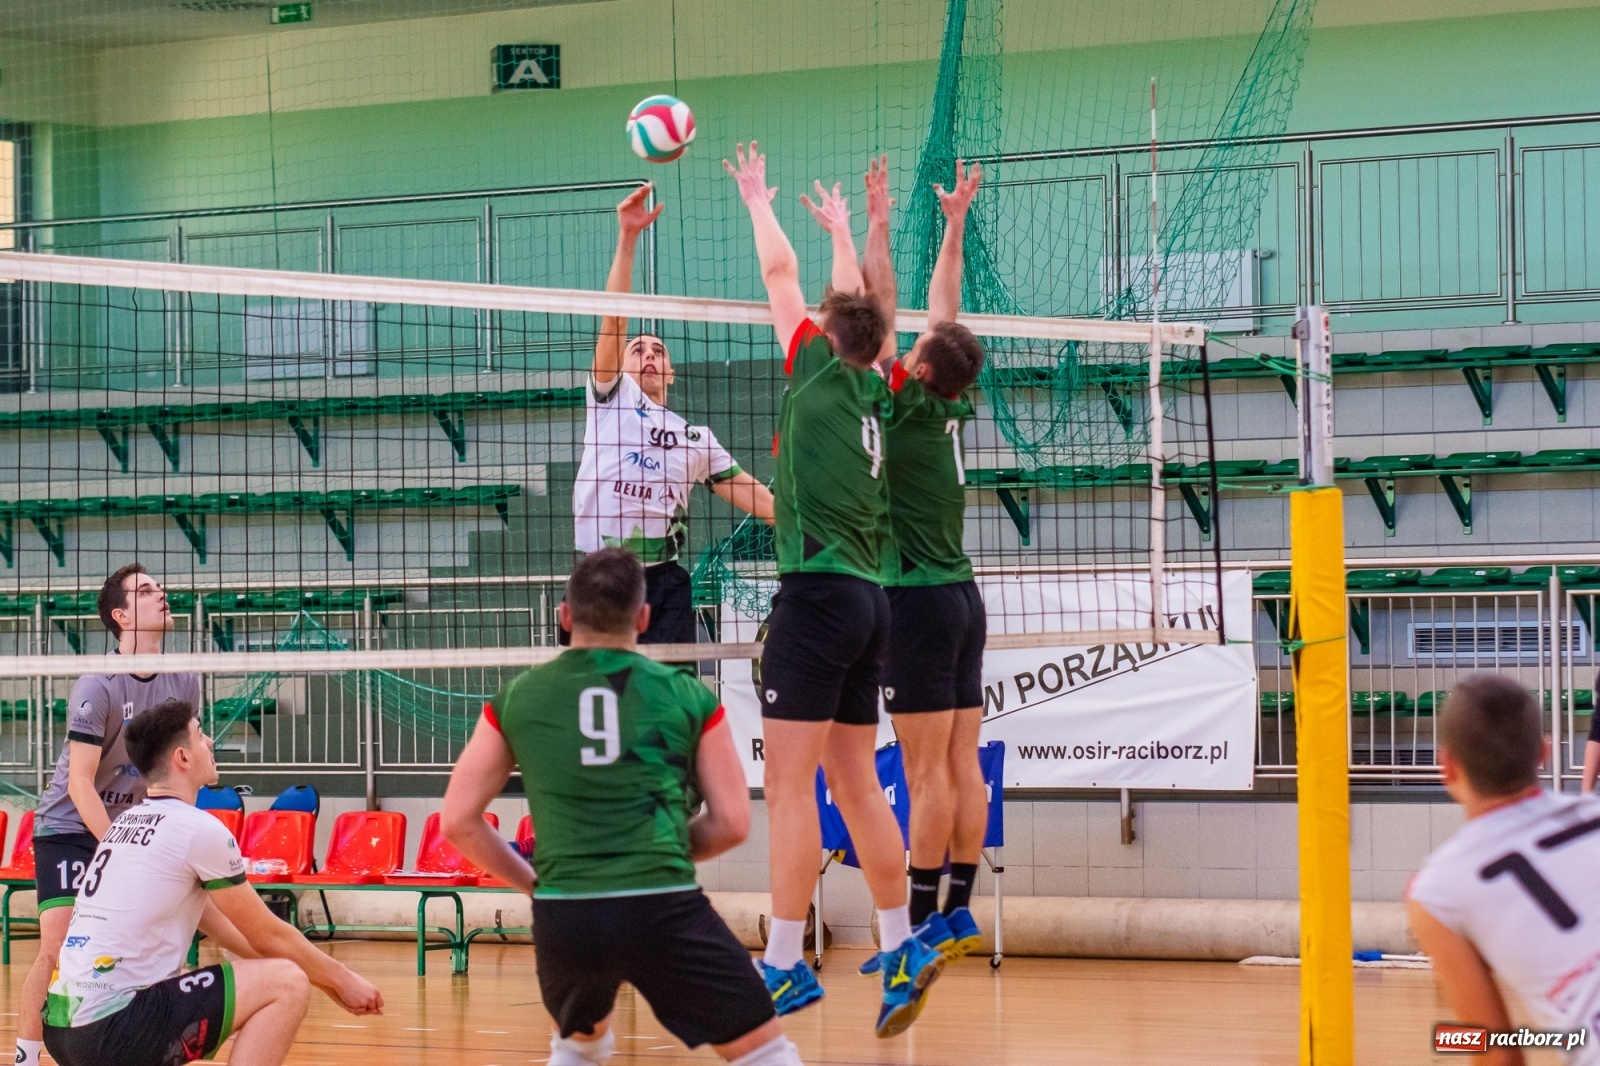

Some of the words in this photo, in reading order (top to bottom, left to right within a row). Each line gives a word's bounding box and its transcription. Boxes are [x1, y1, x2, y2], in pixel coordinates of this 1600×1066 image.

[508, 59, 549, 84] A
[613, 480, 653, 500] DELTA
[579, 687, 621, 766] 9
[1018, 740, 1229, 765] www.osir-raciborz.pl
[102, 825, 156, 847] DZINIEC
[57, 860, 86, 890] 12
[84, 848, 113, 898] 3
[179, 971, 215, 993] 3
